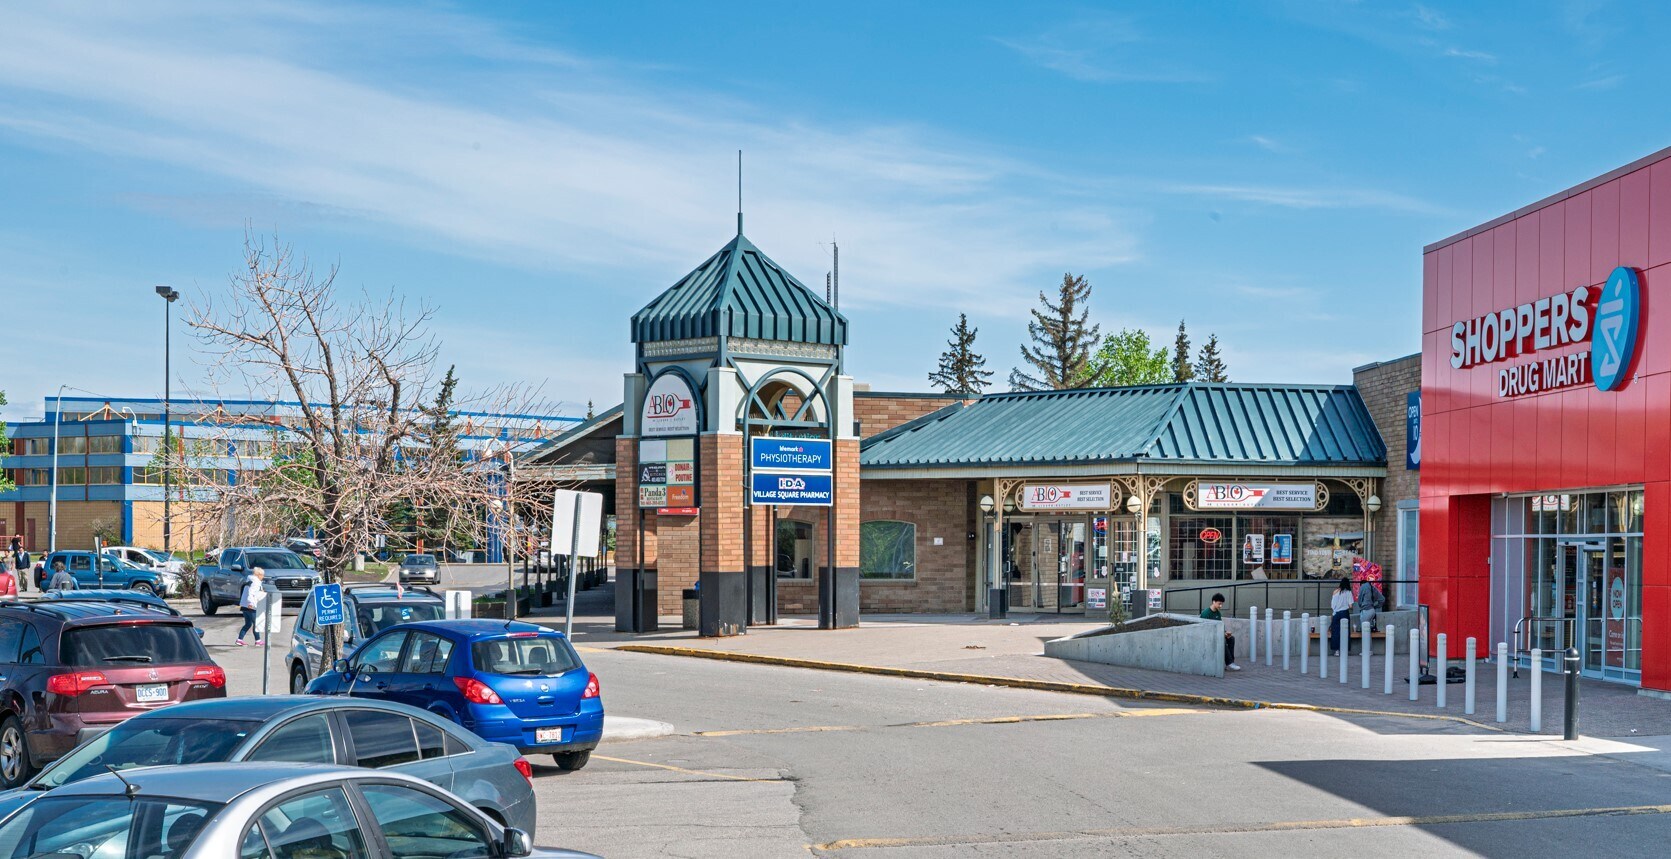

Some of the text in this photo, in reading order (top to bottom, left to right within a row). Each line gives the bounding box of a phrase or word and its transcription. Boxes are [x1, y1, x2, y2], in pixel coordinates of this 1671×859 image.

[1450, 286, 1589, 369] SHOPPERS
[1499, 351, 1588, 397] DRUG MART
[760, 453, 821, 463] PHYSIOTHERAPY
[675, 463, 690, 471] DONAIR
[644, 487, 662, 497] Panda
[662, 487, 666, 497] 3
[778, 491, 799, 499] SQUARE
[1201, 531, 1220, 540] OPEN
[1613, 589, 1622, 598] NOW
[1612, 600, 1622, 608] OPEN
